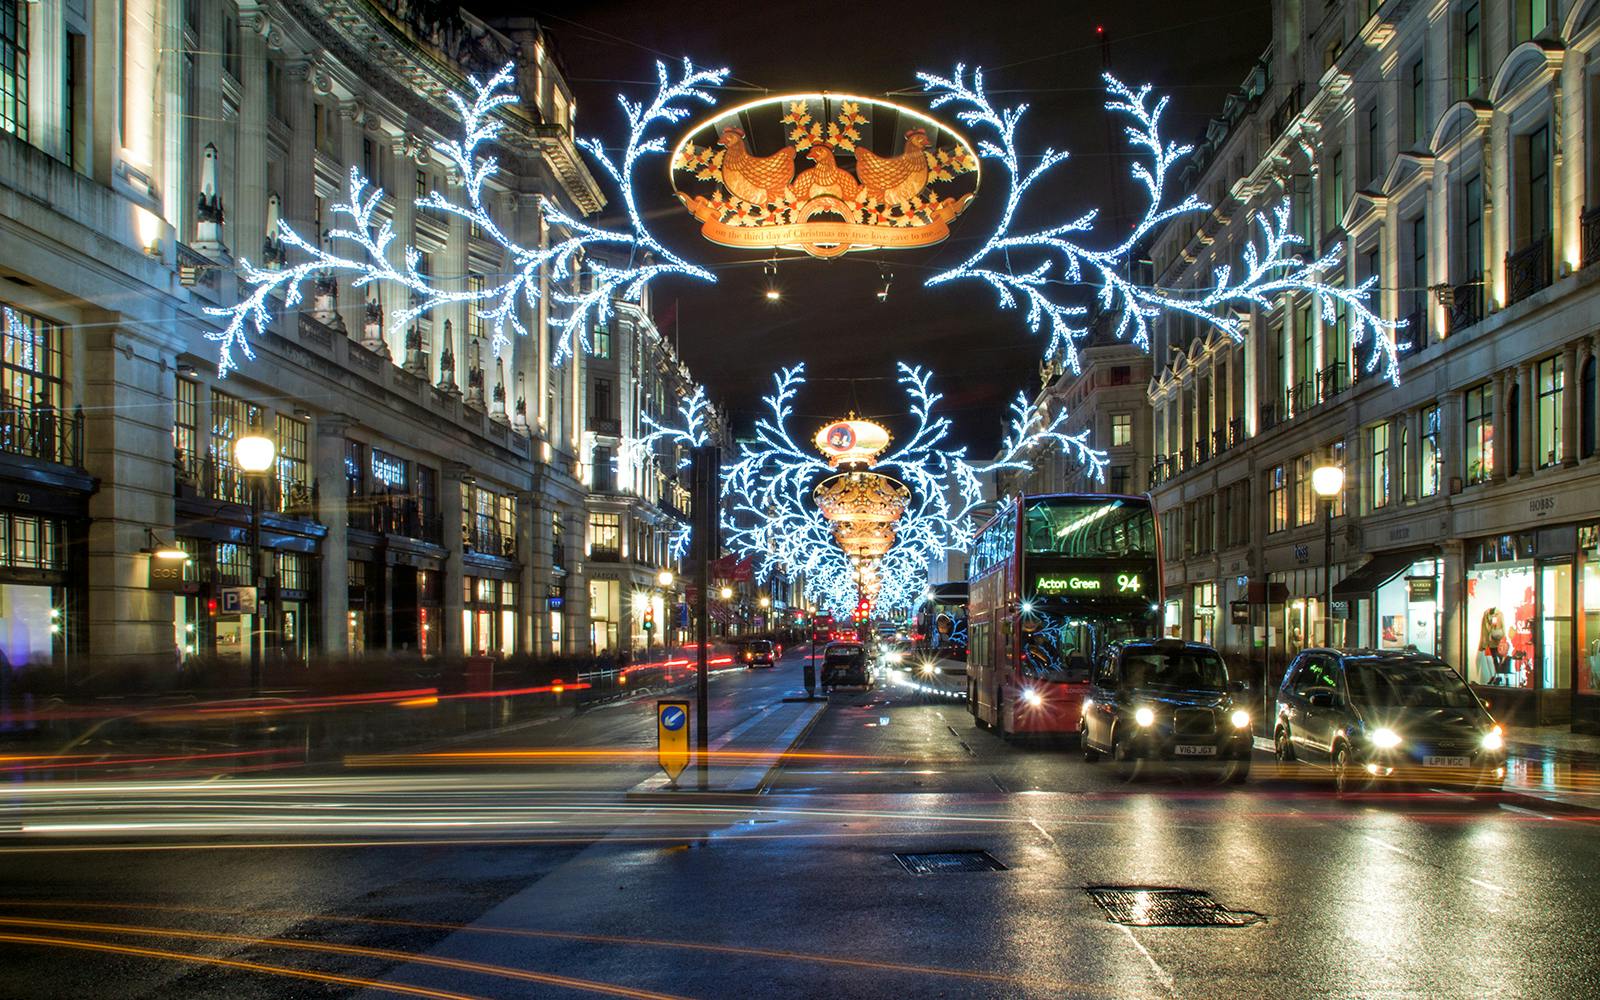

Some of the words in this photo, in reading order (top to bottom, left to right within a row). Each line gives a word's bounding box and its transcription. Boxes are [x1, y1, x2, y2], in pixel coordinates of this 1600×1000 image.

[728, 230, 743, 239] the
[744, 231, 764, 241] third
[766, 231, 780, 242] day
[783, 229, 792, 239] of
[794, 229, 836, 239] Christmas
[837, 231, 849, 241] my
[851, 230, 870, 240] true
[871, 230, 889, 241] love
[911, 231, 920, 240] to
[1529, 497, 1554, 512] HOBBS
[152, 568, 179, 579] COS
[1038, 577, 1067, 589] Acton
[1069, 577, 1101, 589] Green
[1117, 574, 1141, 592] 94
[226, 593, 239, 609] P
[1179, 745, 1197, 754] V163
